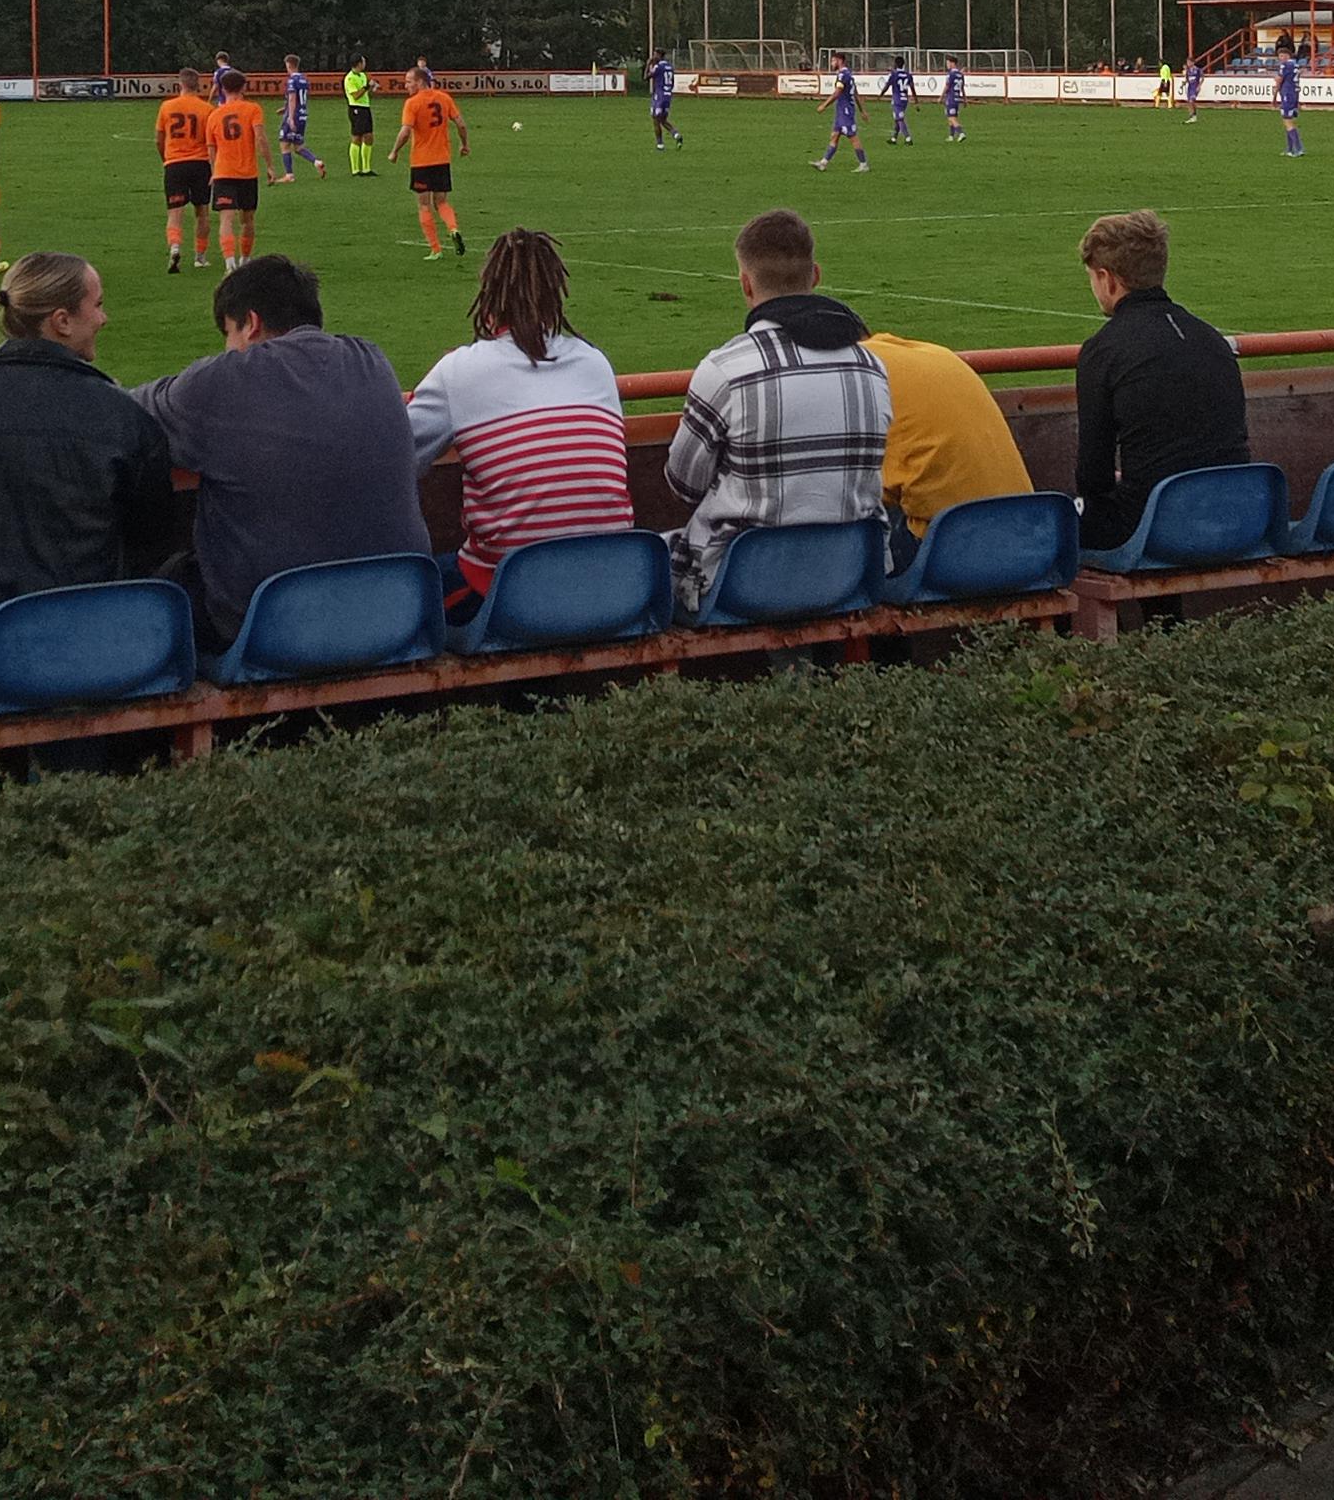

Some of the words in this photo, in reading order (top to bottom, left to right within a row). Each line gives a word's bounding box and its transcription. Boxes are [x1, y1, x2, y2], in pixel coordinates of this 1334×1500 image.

[1325, 86, 1333, 97] A
[169, 112, 199, 140] 21
[222, 114, 243, 141] 6
[427, 101, 444, 128] 3
